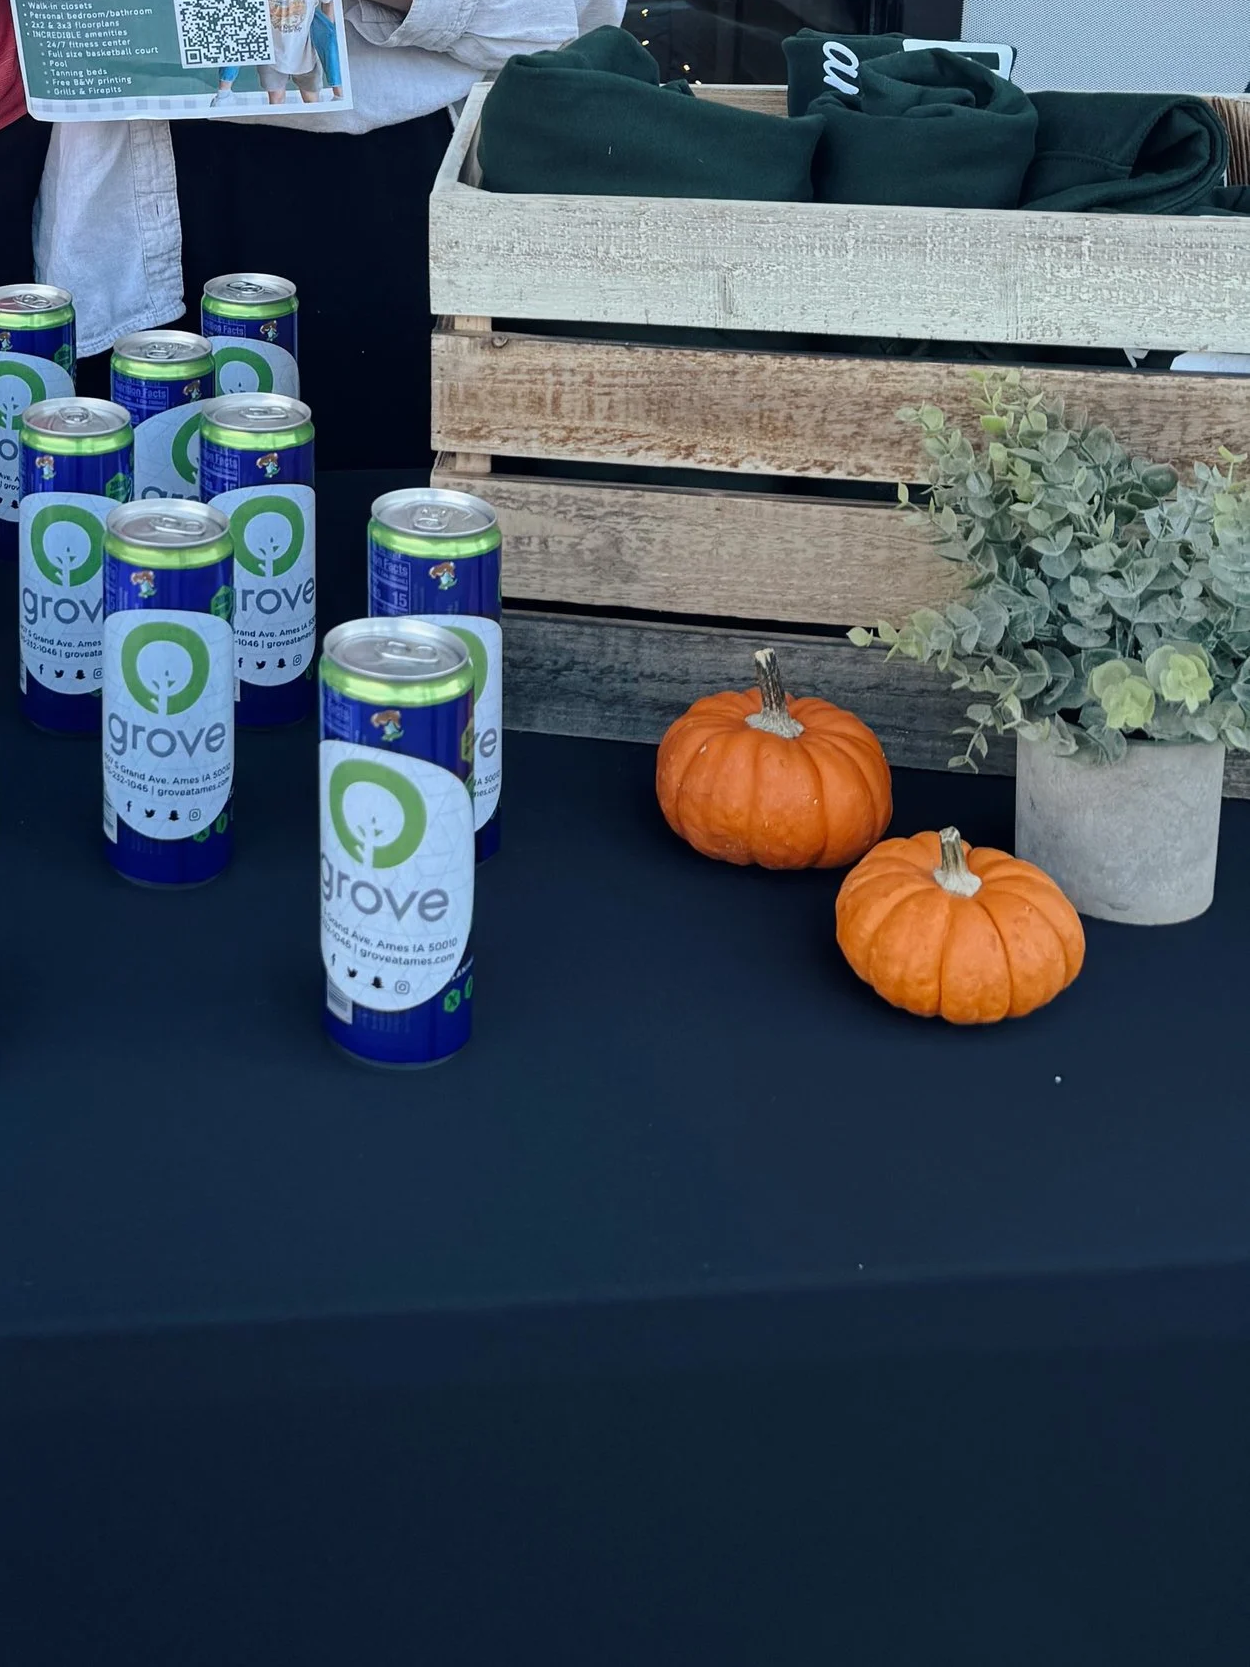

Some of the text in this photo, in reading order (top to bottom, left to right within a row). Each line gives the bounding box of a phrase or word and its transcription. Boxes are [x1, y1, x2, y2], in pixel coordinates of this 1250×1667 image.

[61, 2, 92, 10] closets
[30, 8, 152, 20] Personal bedroom/bathroom
[75, 21, 119, 30] floorplans
[33, 29, 127, 38] INCREDIBLE amenities
[69, 40, 98, 48] fitness
[102, 38, 131, 46] center
[86, 48, 131, 57] basketball
[241, 577, 315, 615] rove
[23, 587, 103, 625] grov
[108, 712, 226, 758] grove
[120, 765, 145, 780] Grand
[173, 776, 199, 785] Ames
[321, 852, 449, 922] grove
[376, 939, 409, 953] Ames
[429, 937, 458, 952] 50010
